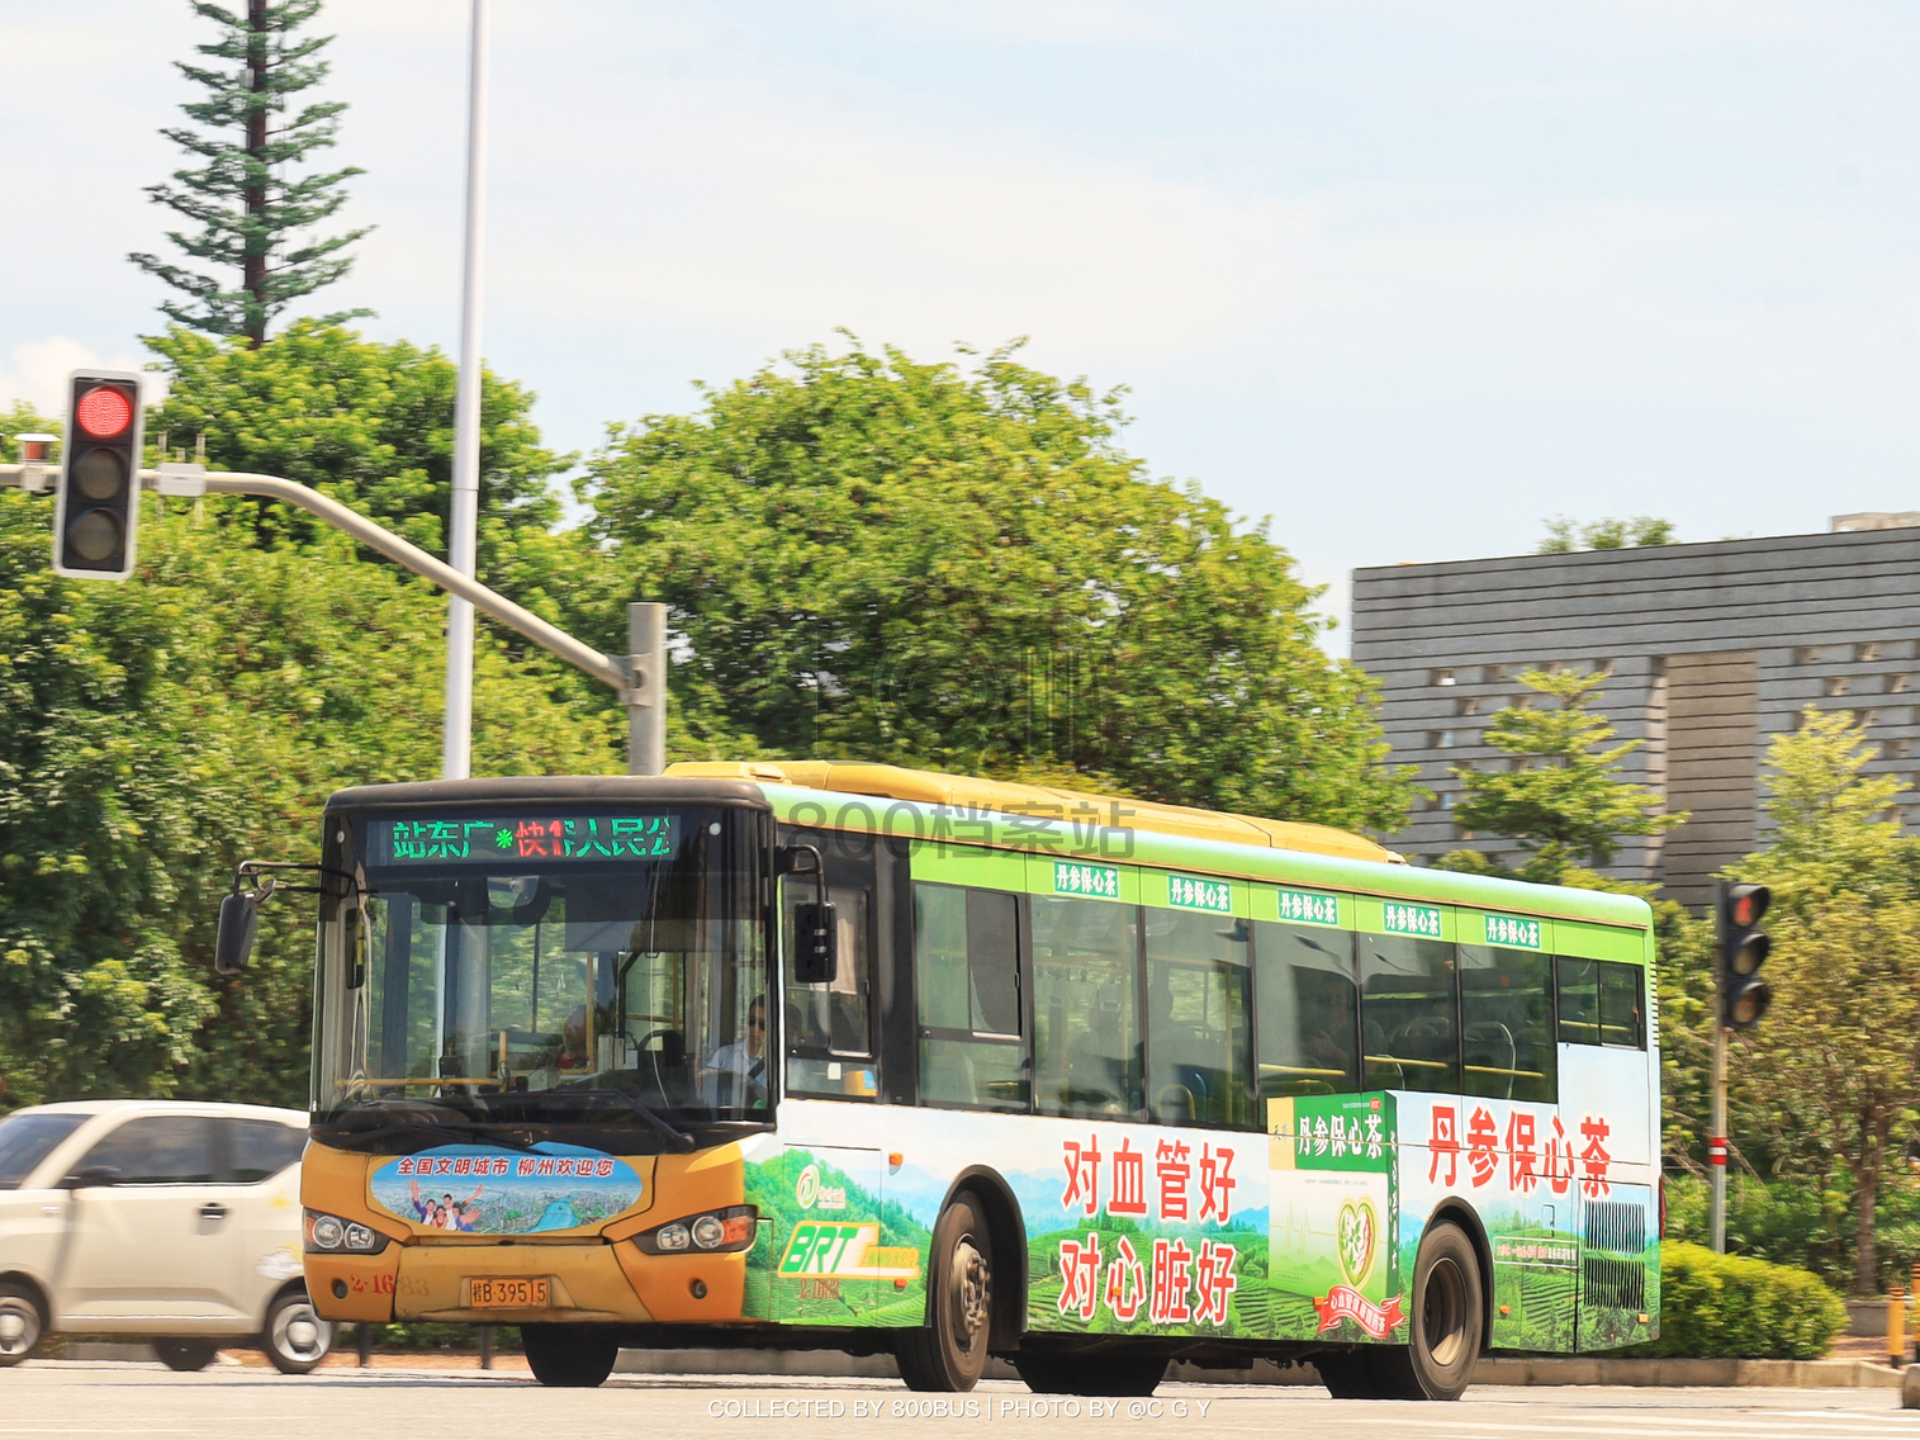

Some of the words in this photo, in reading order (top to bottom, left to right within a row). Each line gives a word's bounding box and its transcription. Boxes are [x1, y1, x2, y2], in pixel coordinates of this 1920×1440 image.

[1055, 864, 1117, 898] 丹参保心茶
[1170, 877, 1230, 911] 丹参保心茶
[1279, 893, 1336, 923] 丹参保心茶
[1385, 905, 1439, 935] 丹参保心茶
[1486, 917, 1539, 948] 丹参保心茶
[1298, 1113, 1383, 1160] 丹参保心茶
[1428, 1105, 1612, 1199] 丹参保心茶
[397, 1157, 510, 1176] 全国文明城市
[517, 1157, 615, 1177] 柳州欢迎您
[1062, 1133, 1237, 1223] 对血管好
[781, 1225, 860, 1274] BRT
[1058, 1235, 1235, 1324] 对心脏好
